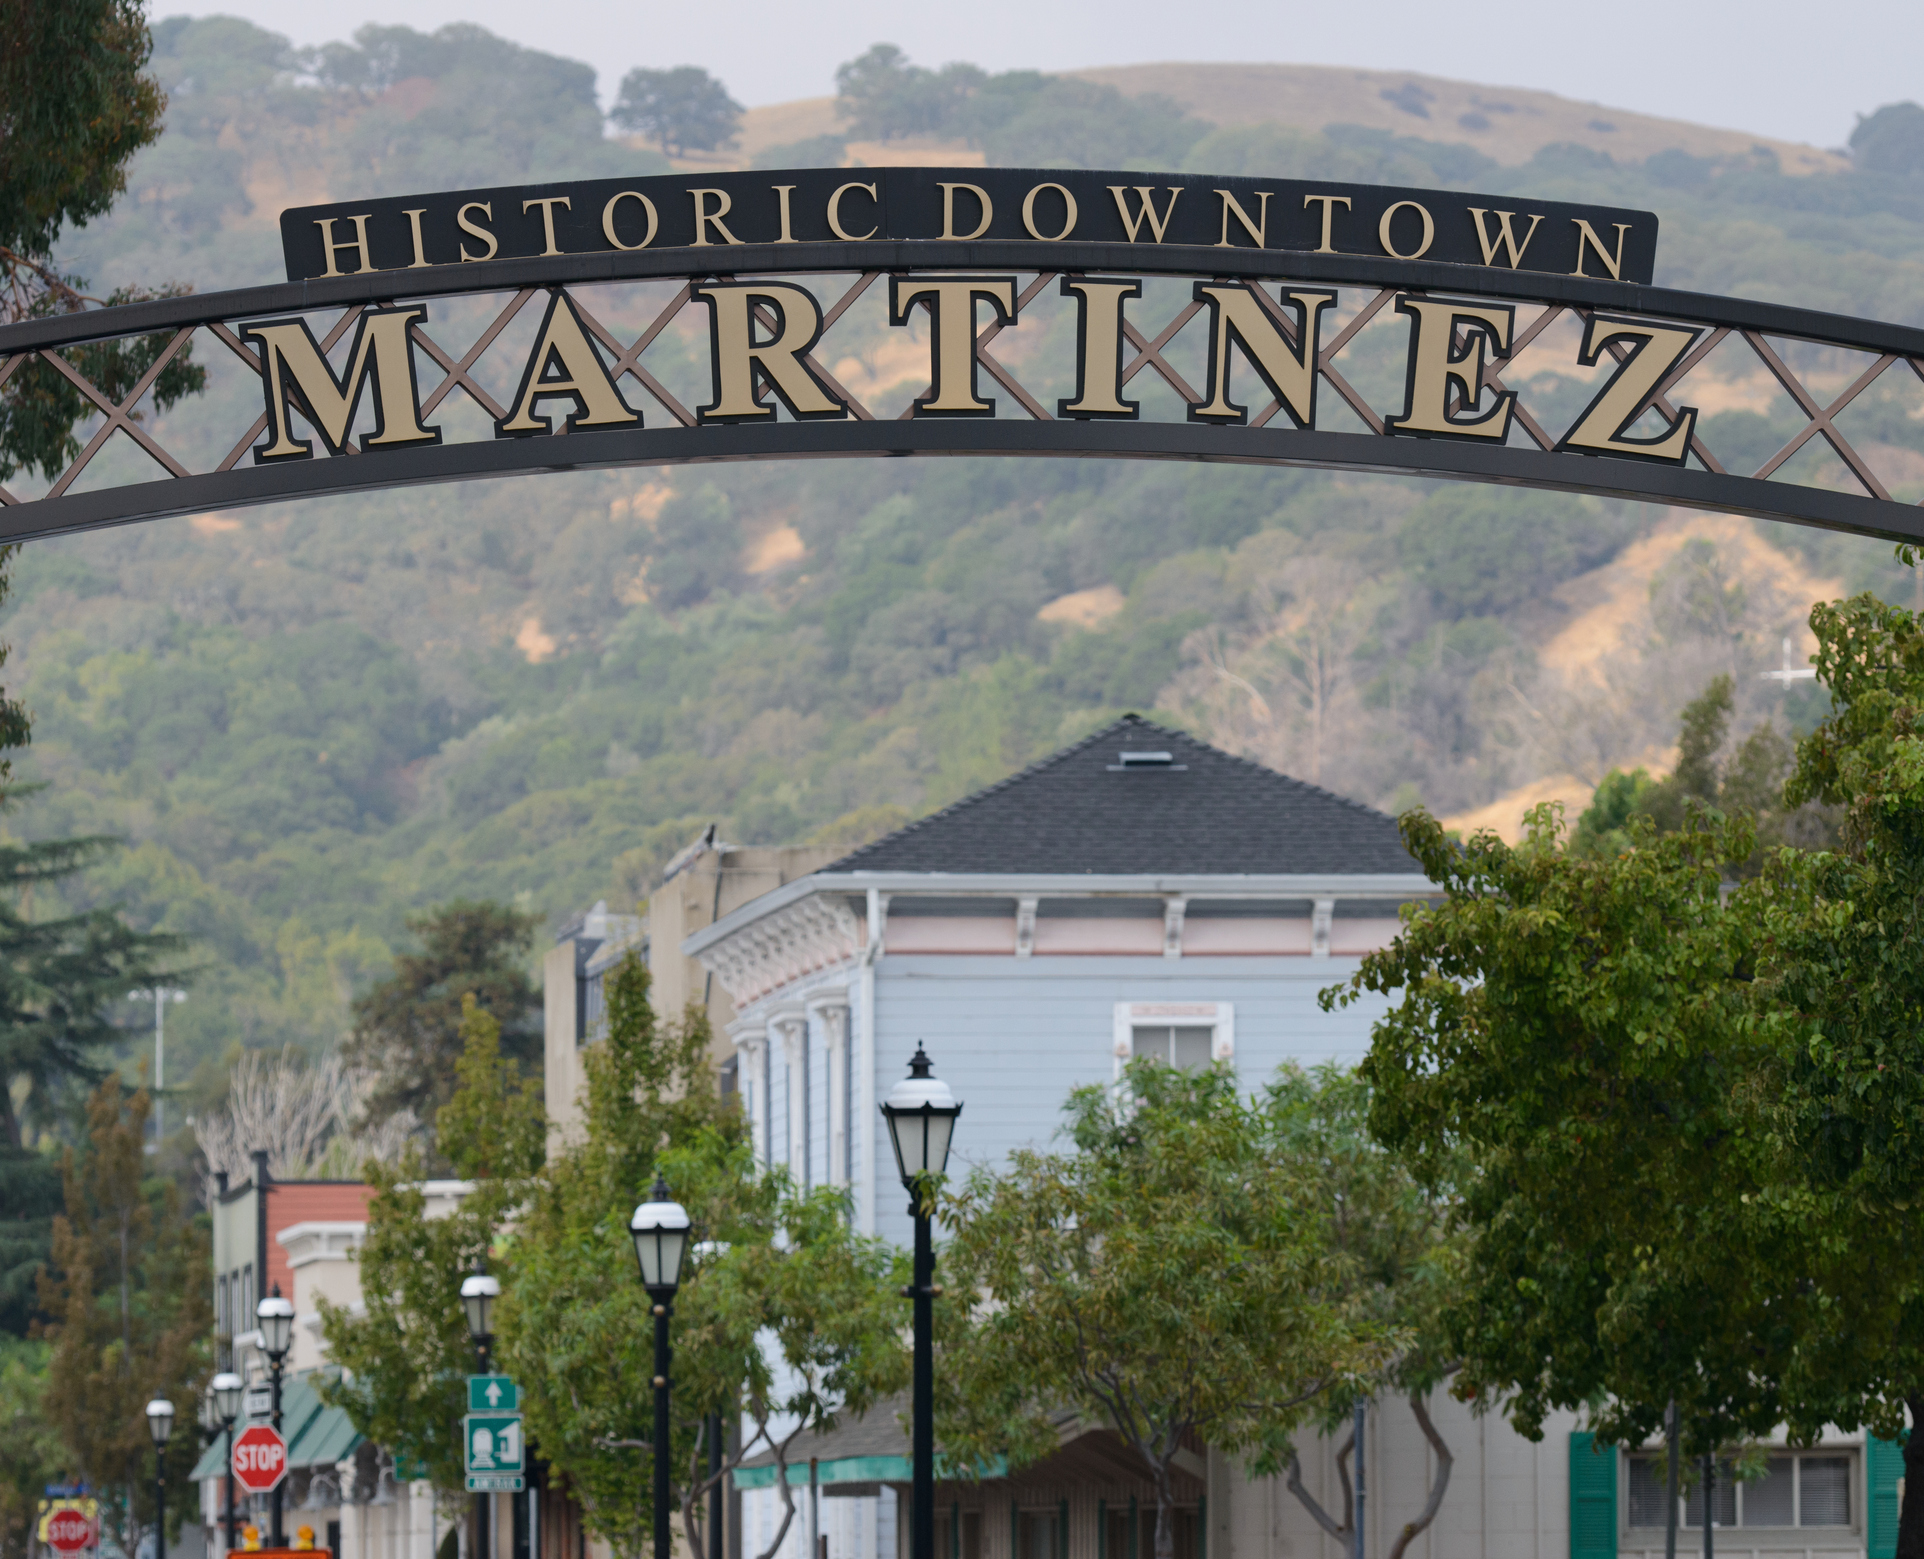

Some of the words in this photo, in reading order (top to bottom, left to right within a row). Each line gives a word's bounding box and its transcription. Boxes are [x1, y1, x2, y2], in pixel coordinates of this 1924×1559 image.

[313, 181, 880, 278] HISTORIC
[935, 181, 1633, 281] DOWNTOWN
[241, 277, 1706, 463] MARTINEZ
[235, 1443, 284, 1472] STOP
[48, 1520, 89, 1541] STOP
